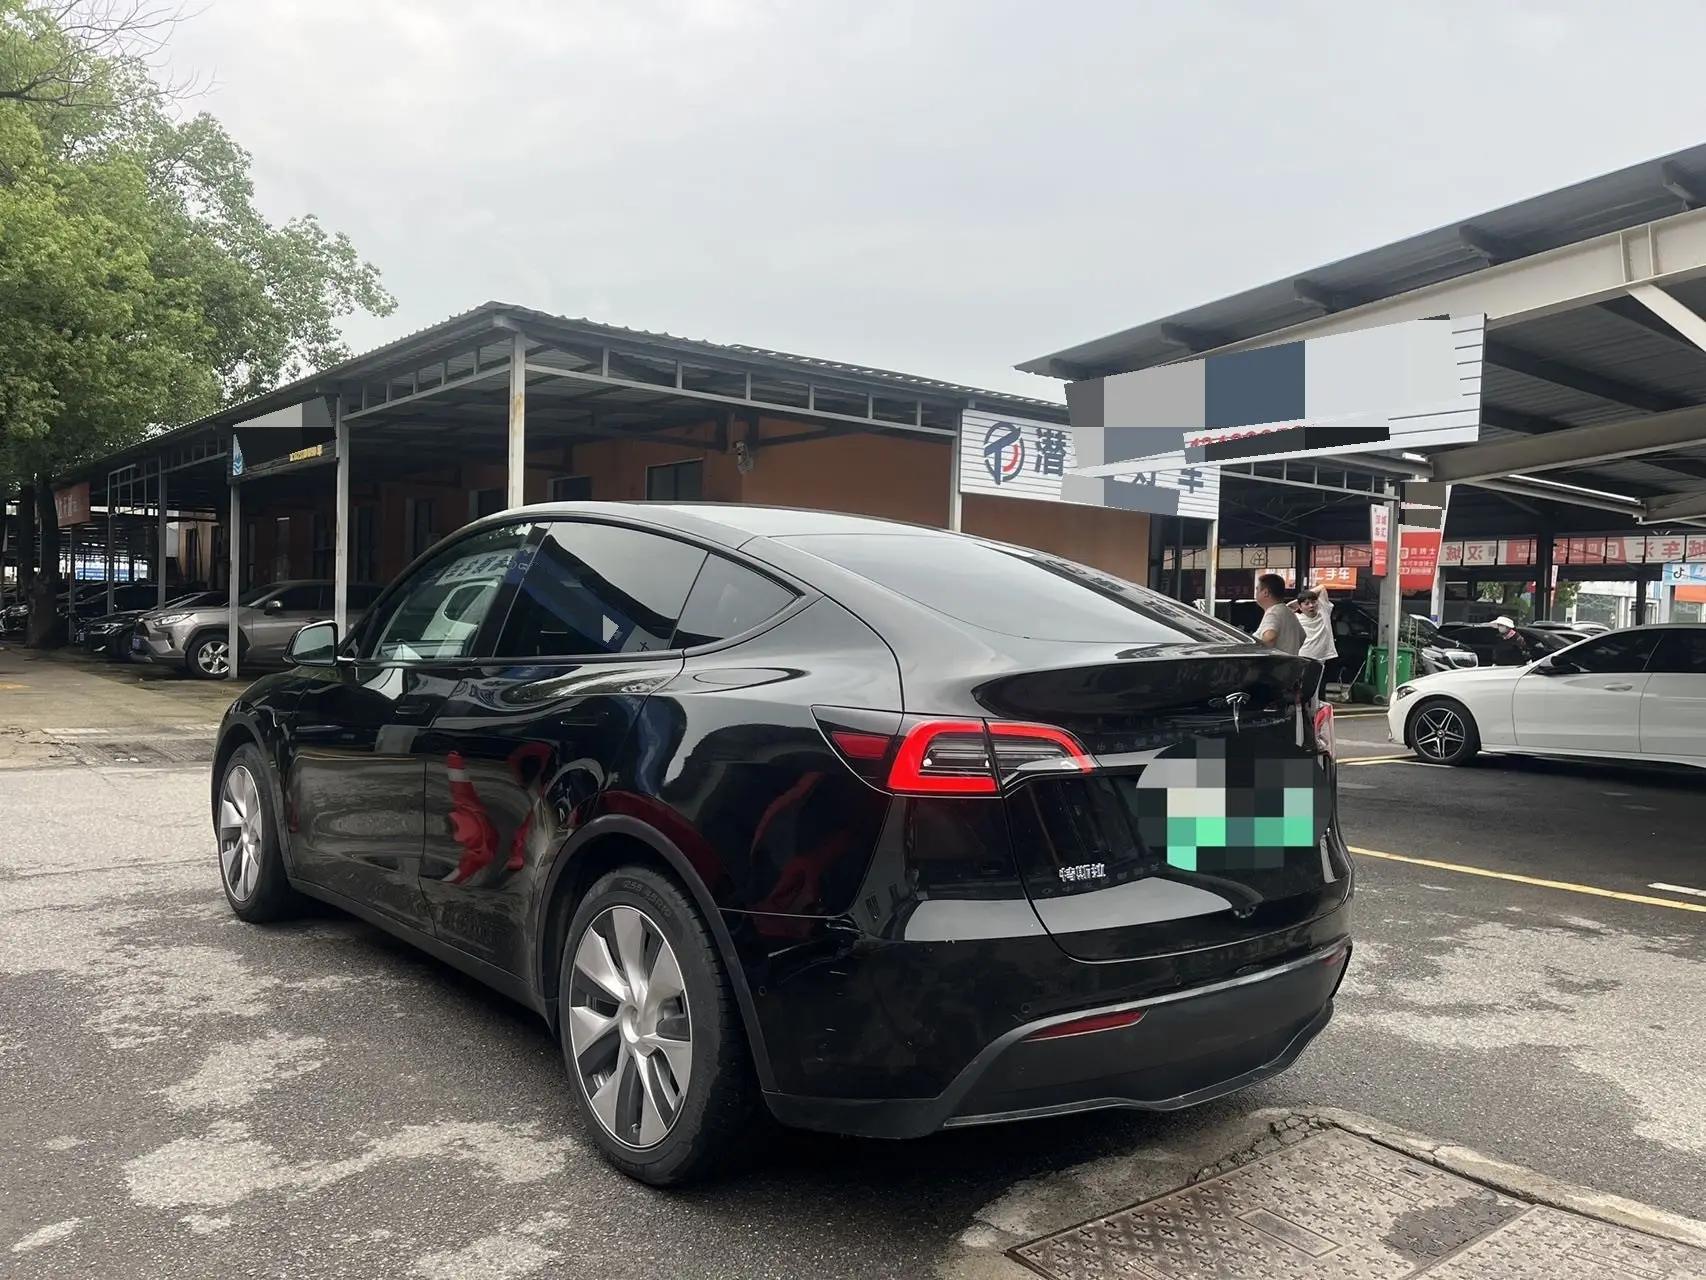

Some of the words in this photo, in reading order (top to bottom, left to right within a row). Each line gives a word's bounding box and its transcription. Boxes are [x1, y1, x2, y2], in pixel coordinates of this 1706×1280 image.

[1314, 567, 1350, 580] 二手车
[1059, 863, 1106, 882] 特斯拉
